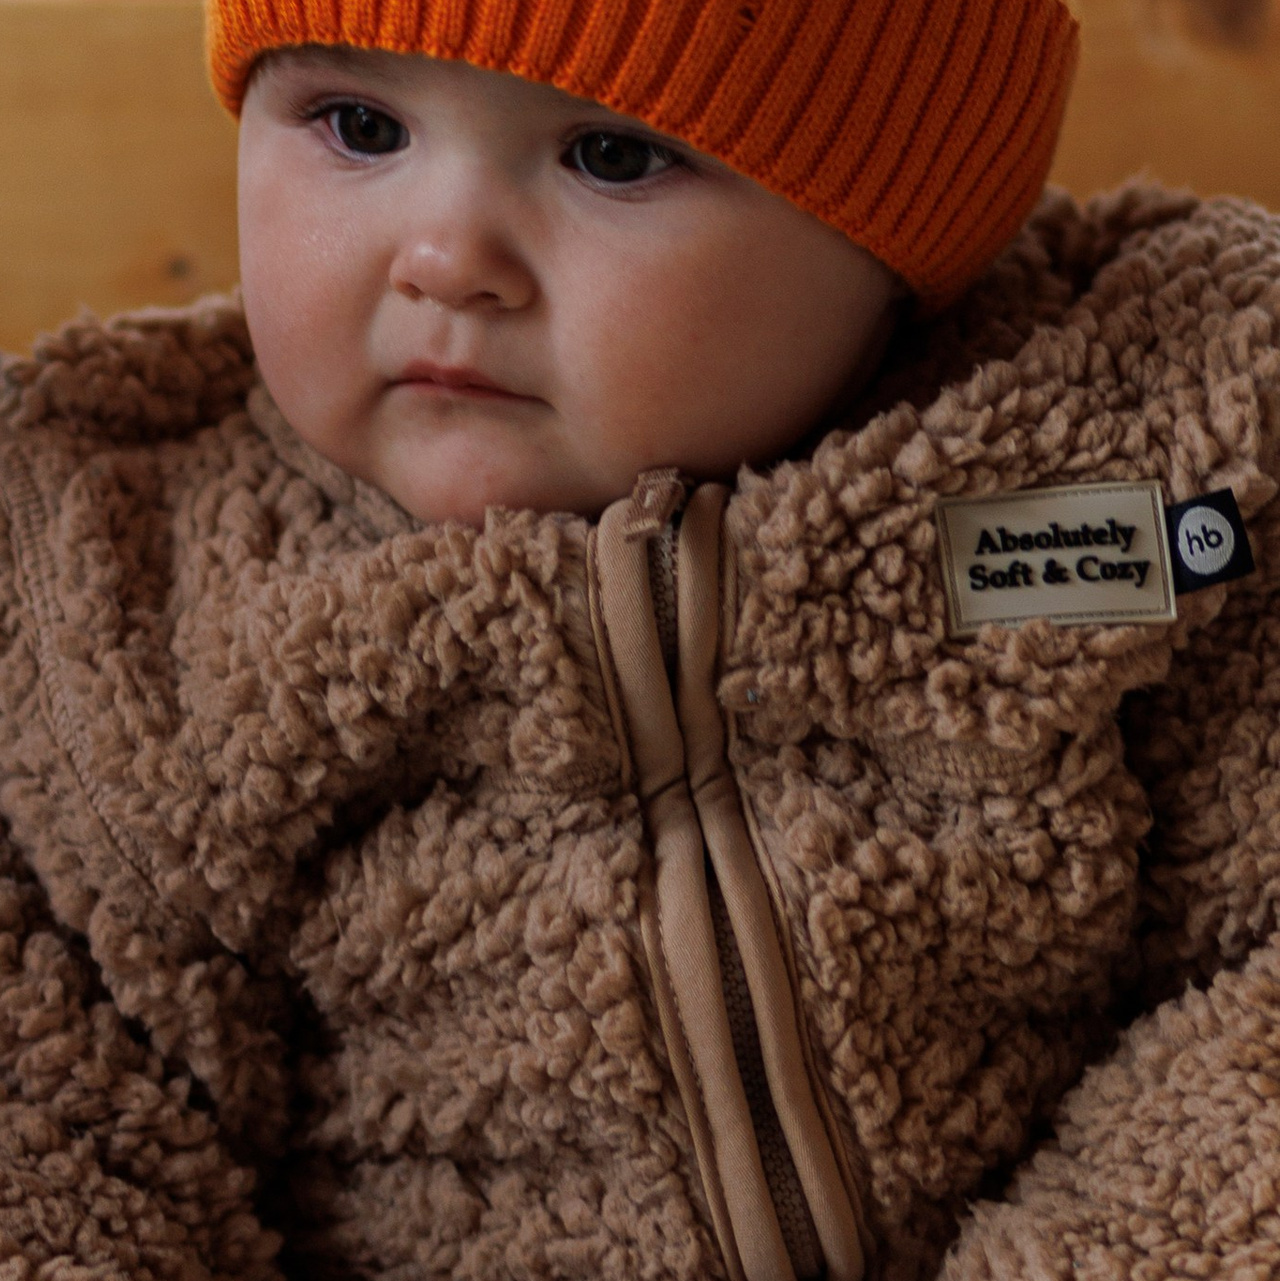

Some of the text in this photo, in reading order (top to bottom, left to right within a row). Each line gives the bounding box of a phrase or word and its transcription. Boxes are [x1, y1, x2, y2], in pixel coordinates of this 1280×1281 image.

[974, 519, 1136, 555] Absolutely
[1185, 524, 1224, 556] hb
[969, 556, 1151, 591] Soft & Cozy
